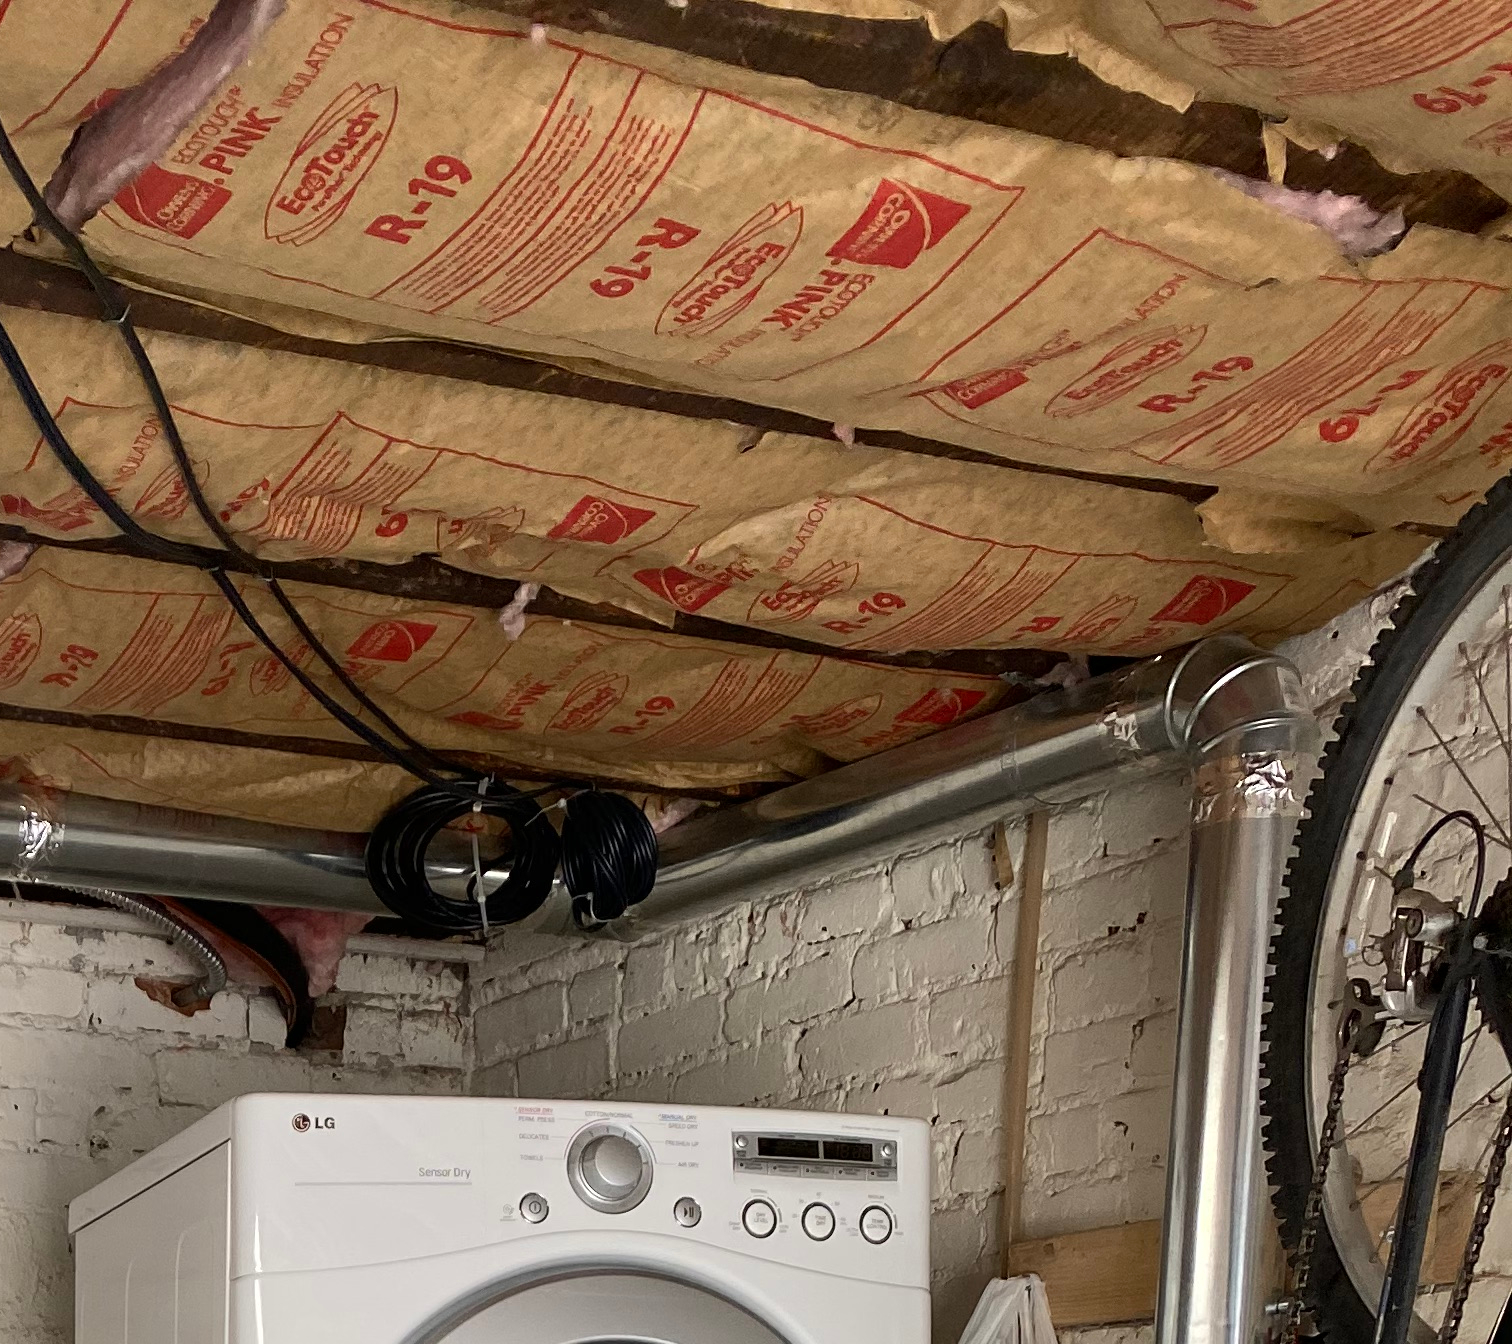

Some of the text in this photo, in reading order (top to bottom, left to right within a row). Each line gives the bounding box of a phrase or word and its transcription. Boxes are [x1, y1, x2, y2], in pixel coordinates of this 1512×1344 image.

[200, 12, 356, 176] PINK INSULATION
[276, 110, 381, 216] EcoTouch
[364, 154, 473, 245] R-19
[589, 217, 702, 298] R-19
[673, 242, 786, 325] EcoTouch
[762, 268, 848, 331] PINK
[1138, 355, 1255, 413] R-19
[821, 591, 907, 635] R-19
[608, 695, 676, 735] R-19
[314, 1116, 336, 1129] LG
[418, 1166, 472, 1179] Sensor Dry
